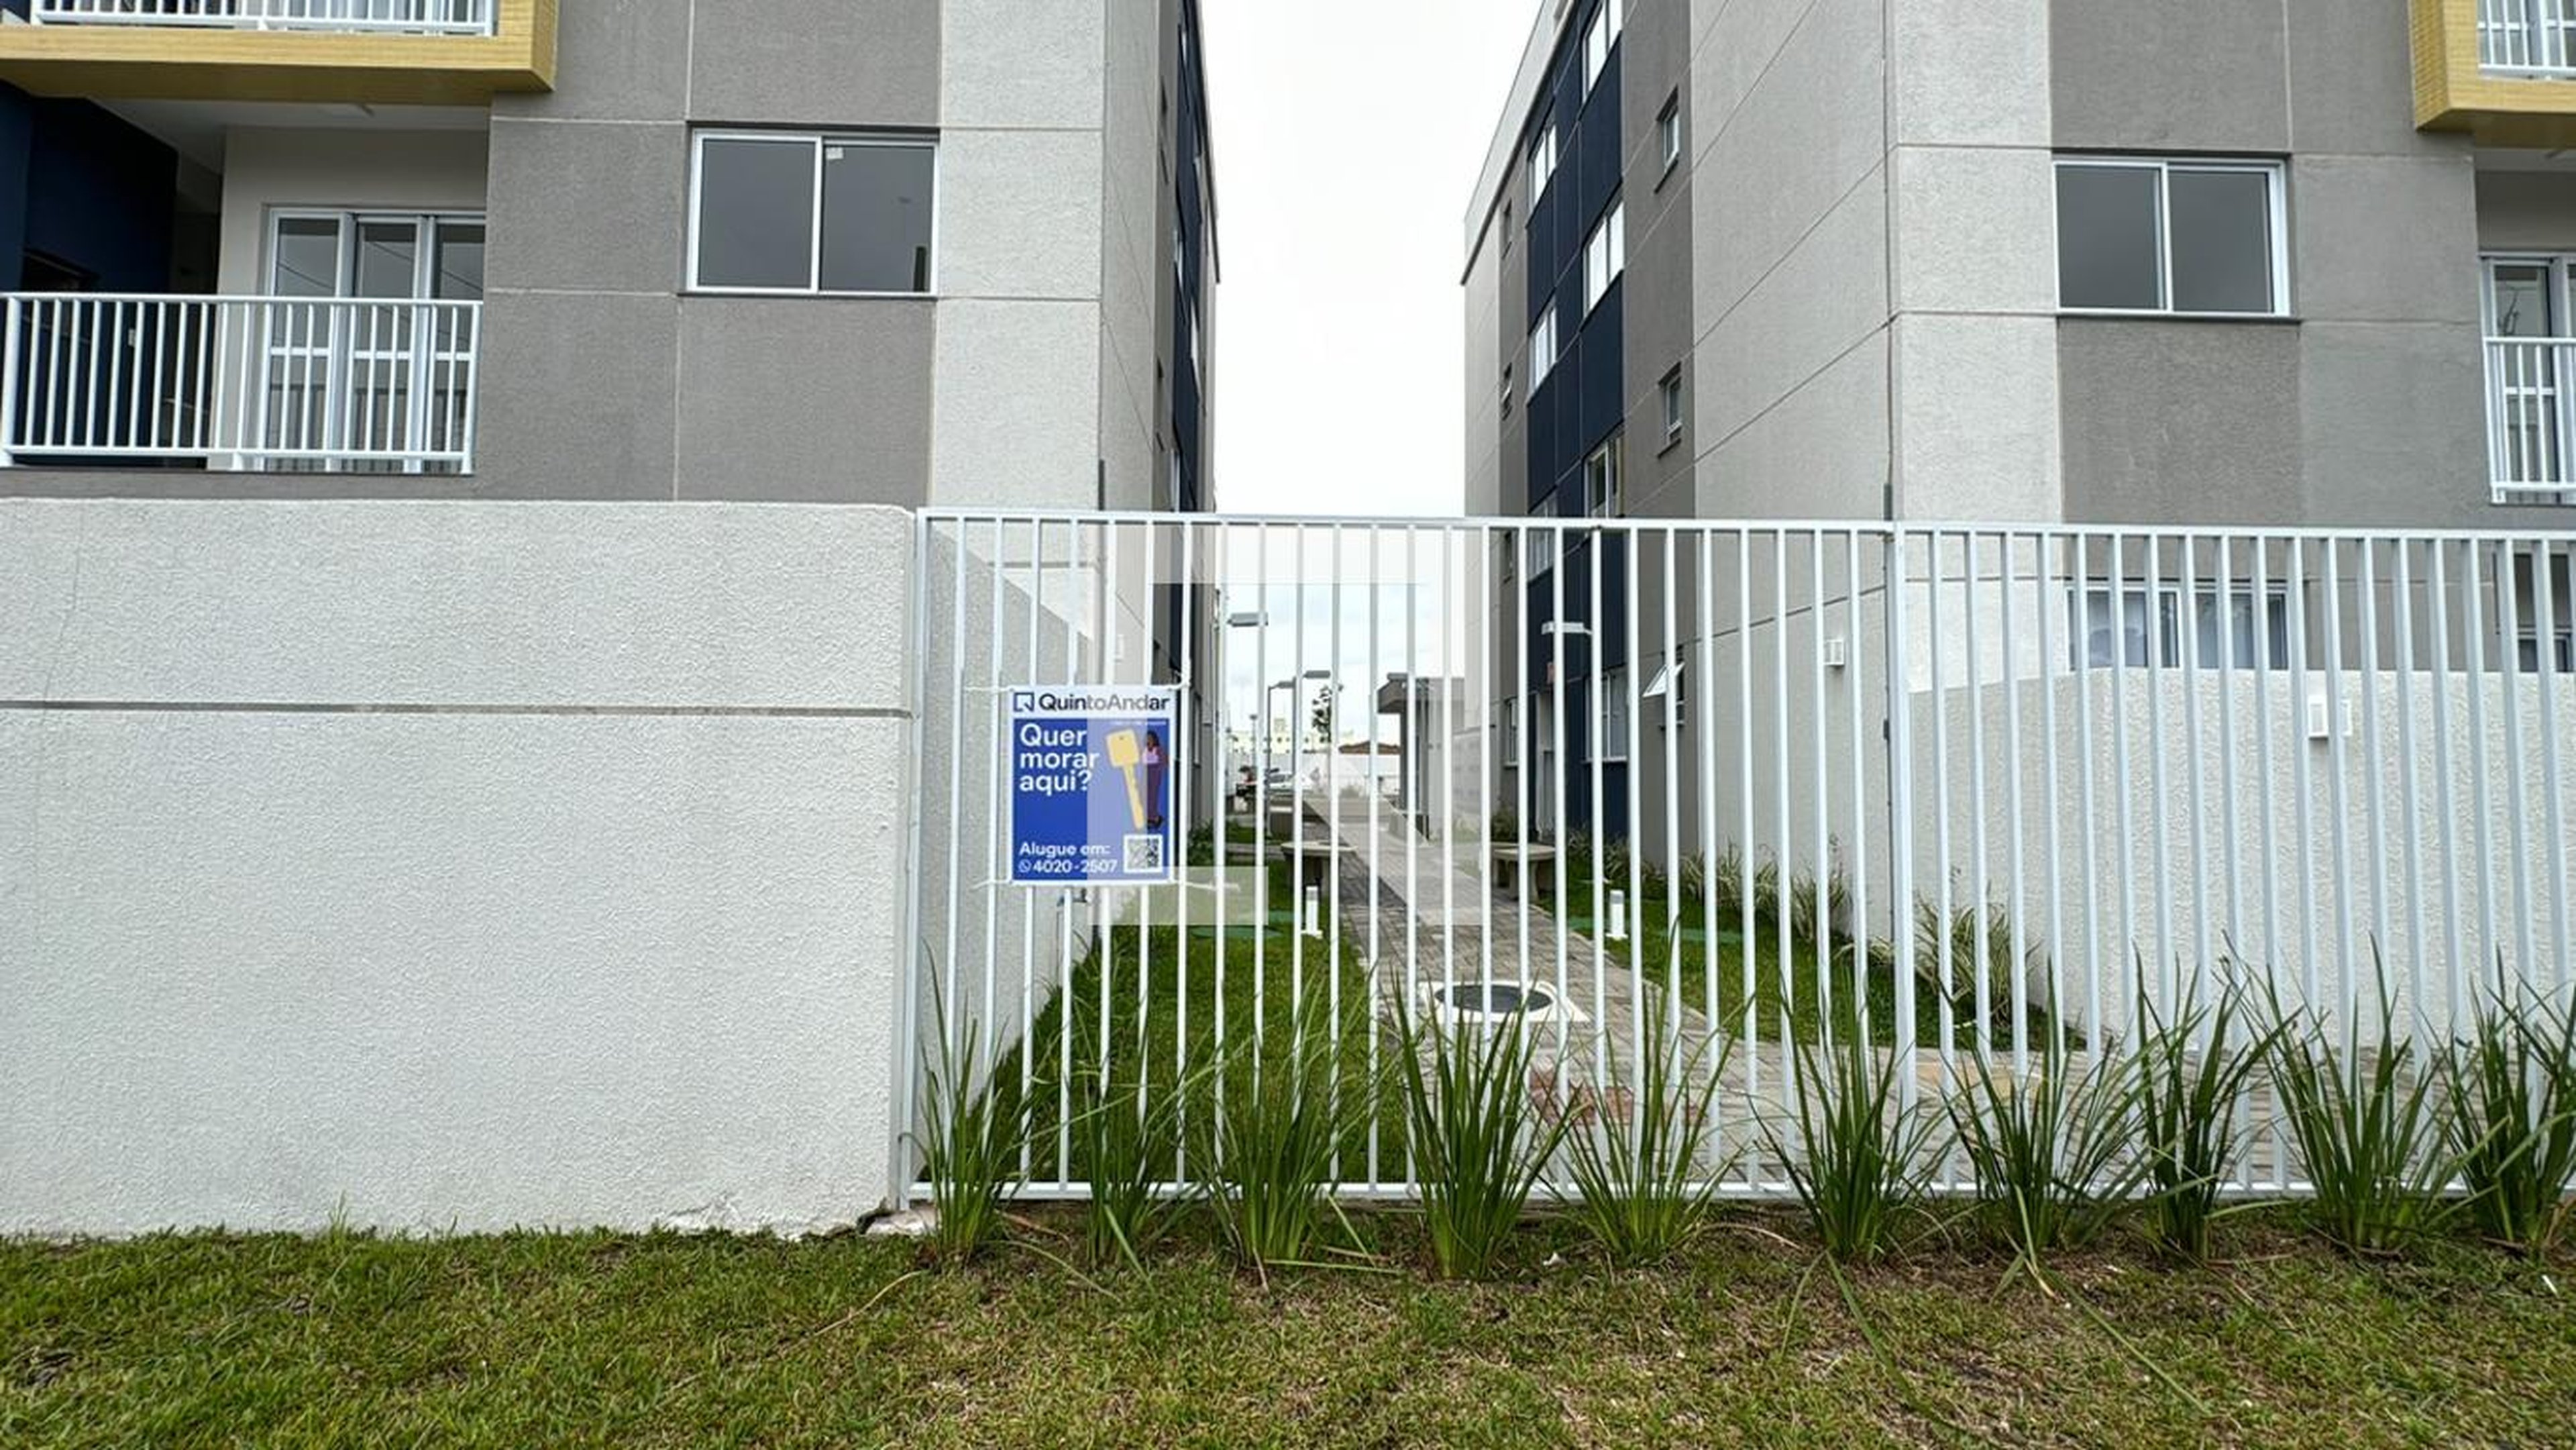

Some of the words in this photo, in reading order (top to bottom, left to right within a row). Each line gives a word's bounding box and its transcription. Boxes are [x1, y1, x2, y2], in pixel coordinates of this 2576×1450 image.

[1038, 693, 1170, 711] QuintoAndar
[1020, 723, 1087, 746] Quer
[1020, 752, 1099, 769] morar
[1019, 770, 1093, 796] aqui?
[1018, 841, 1076, 857] Alugue
[1080, 844, 1111, 855] em:
